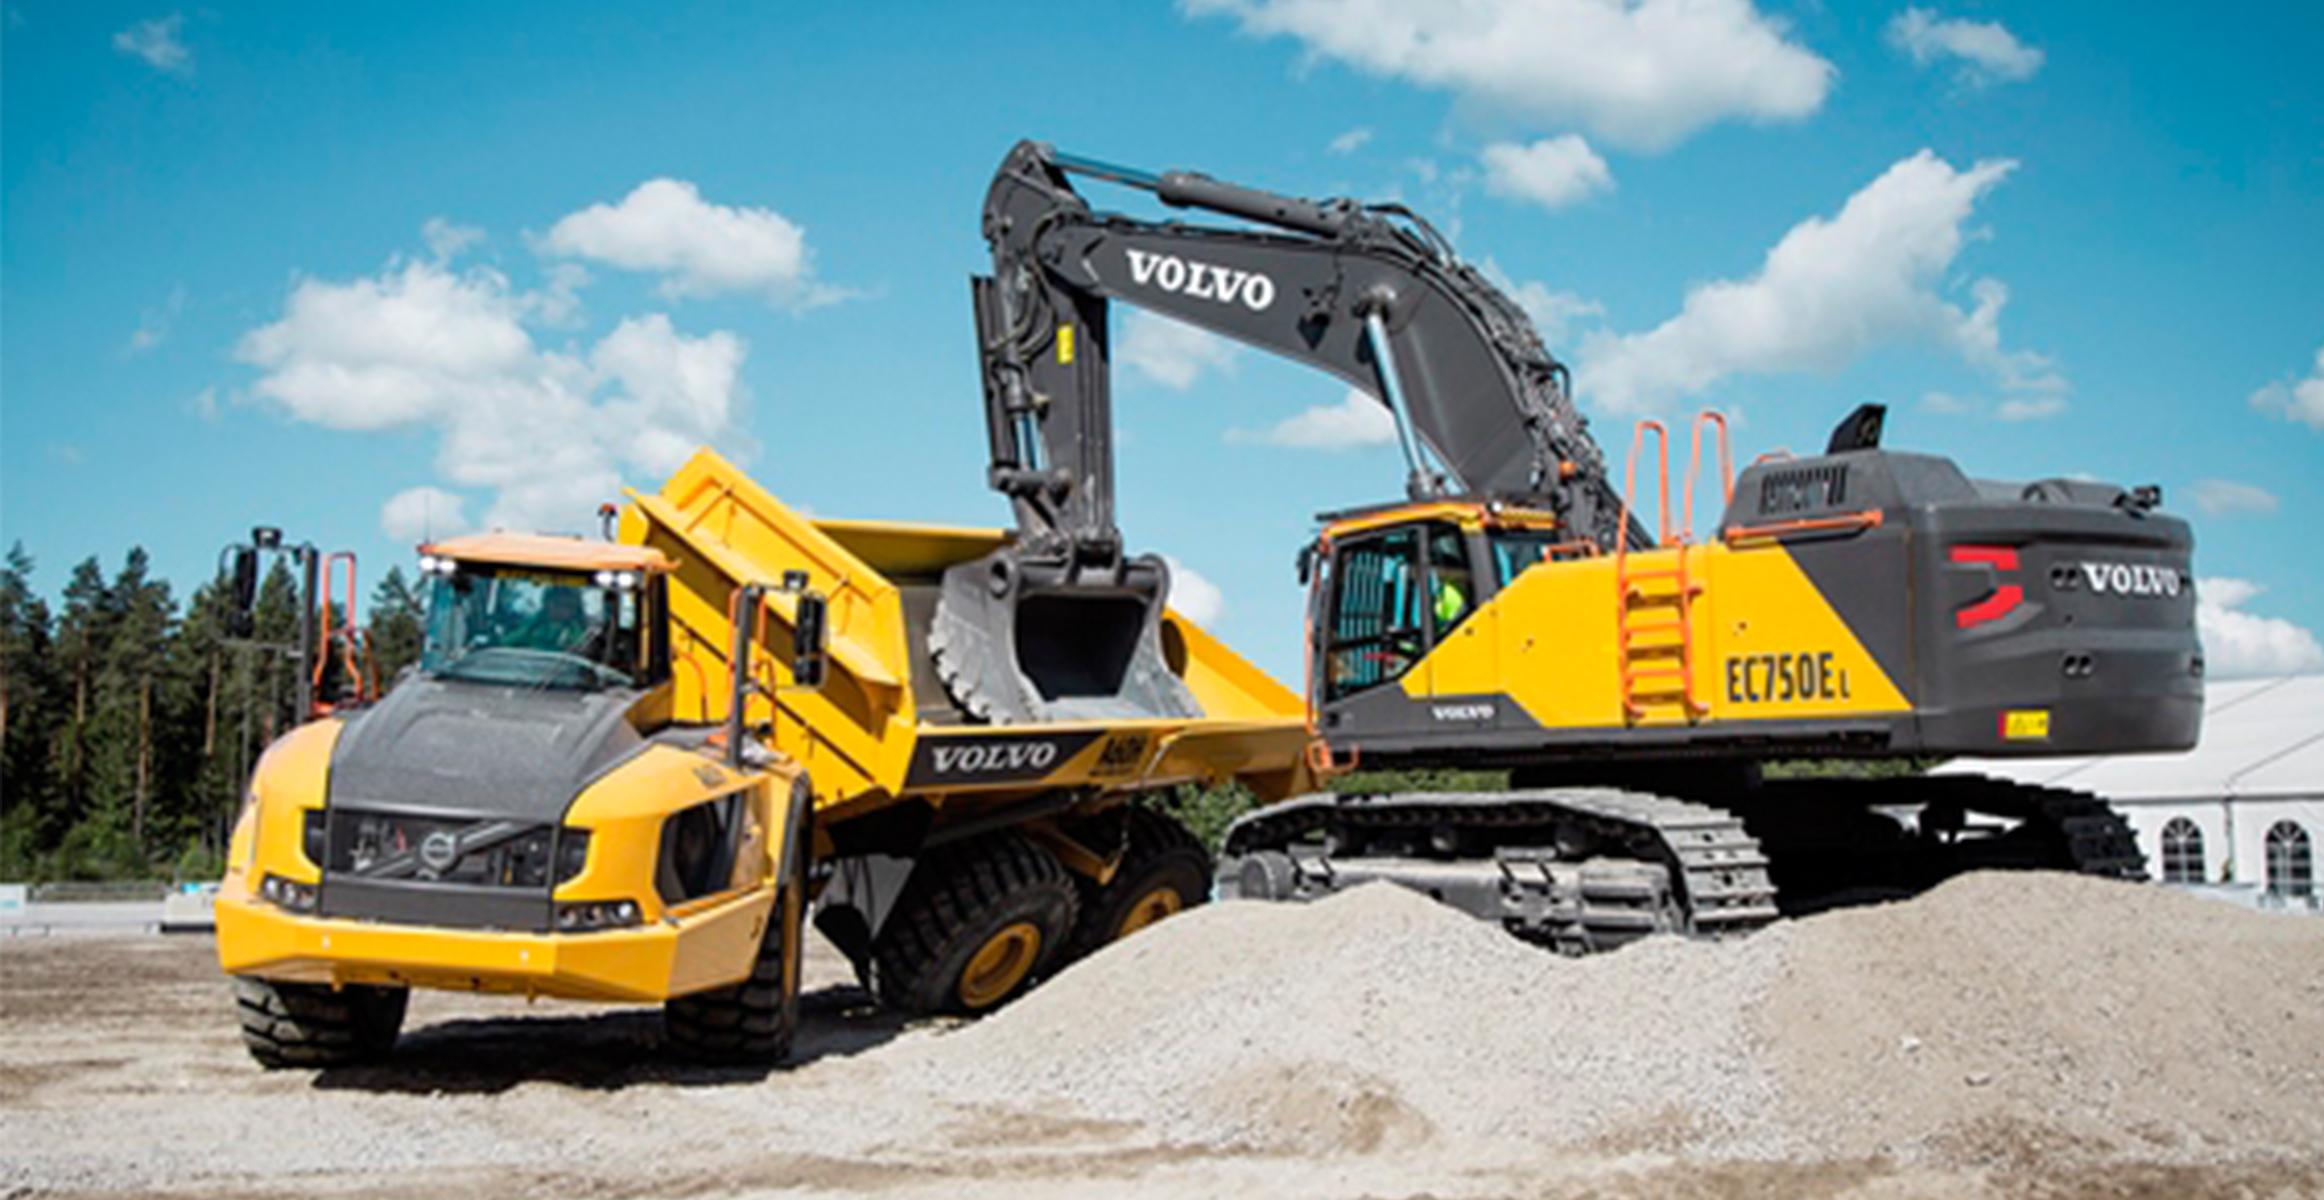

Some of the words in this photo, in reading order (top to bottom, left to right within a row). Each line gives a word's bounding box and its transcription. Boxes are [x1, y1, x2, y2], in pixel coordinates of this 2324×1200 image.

[1126, 249, 1274, 311] VOLVO
[2080, 562, 2180, 597] VOLVO
[1727, 652, 1835, 702] EC750E
[1431, 705, 1495, 721] VOLVO
[931, 742, 1057, 773] VOLVO
